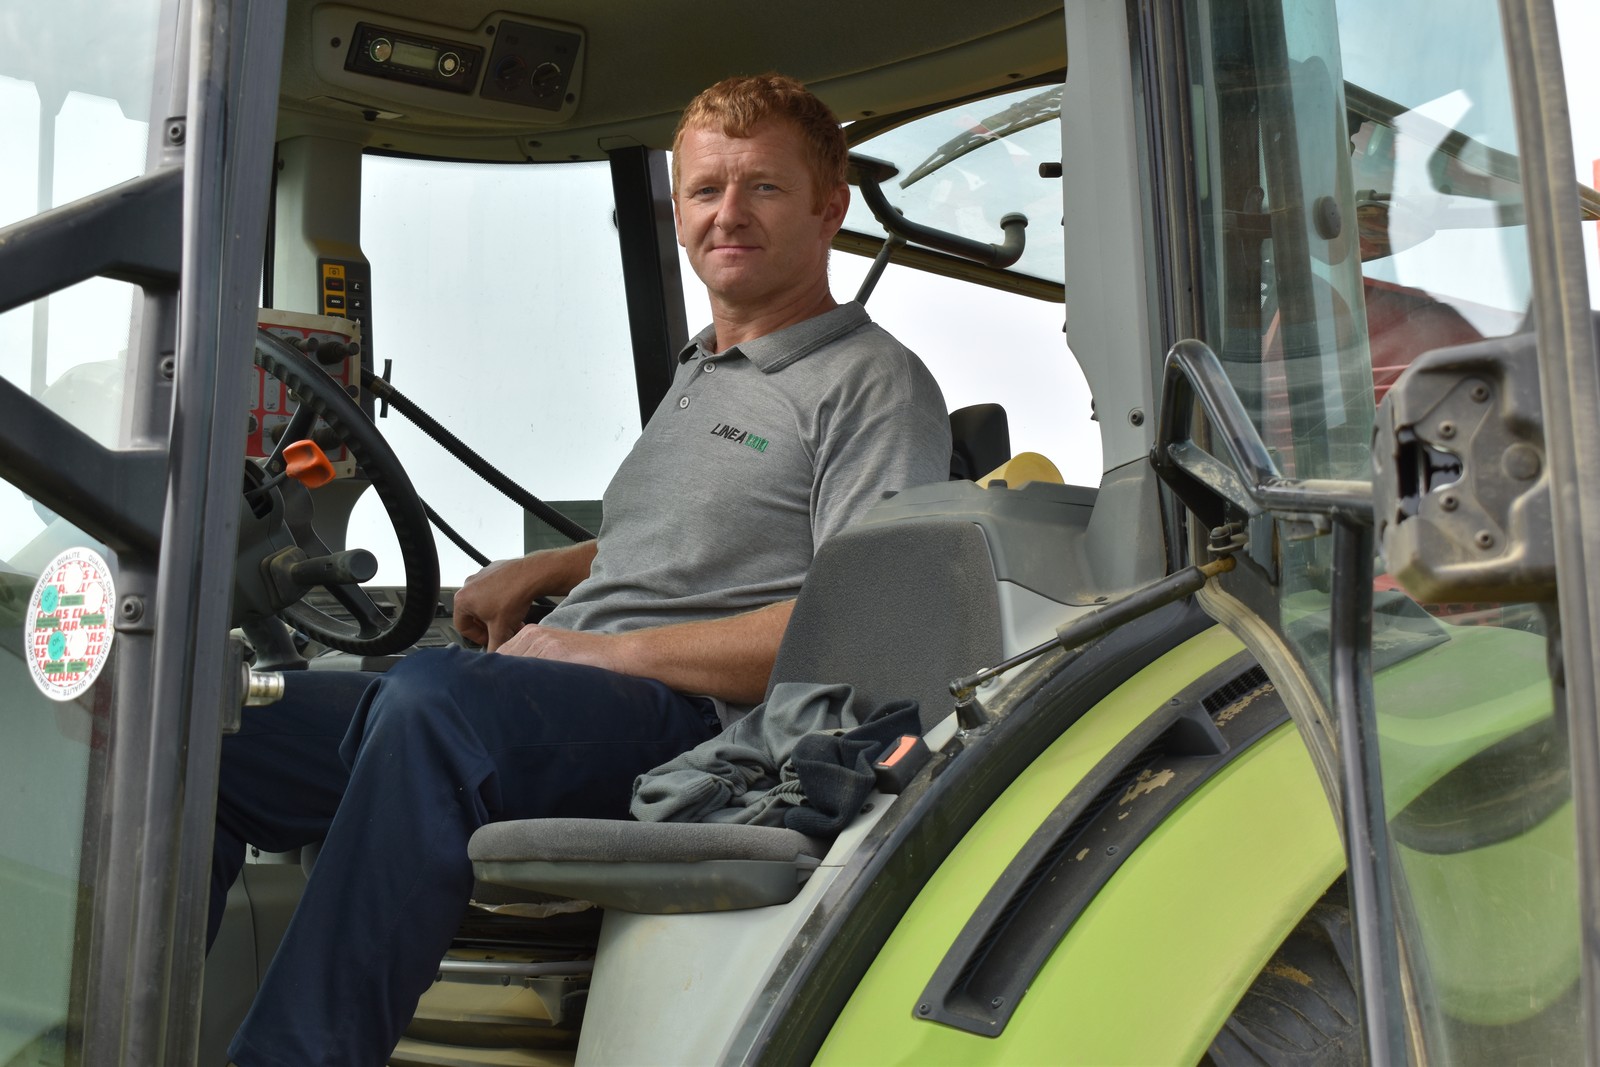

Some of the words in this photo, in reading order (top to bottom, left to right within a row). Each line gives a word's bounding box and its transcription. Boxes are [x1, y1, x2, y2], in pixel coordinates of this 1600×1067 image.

[33, 567, 55, 607] CONTROLE
[57, 552, 80, 566] QUALITE
[88, 554, 107, 578] QUALITY
[106, 580, 114, 610] CHECK
[88, 636, 111, 680] CONTROLE
[32, 664, 50, 691] QUALITY
[47, 672, 80, 682] CLAAS
[63, 680, 87, 696] QUALITE
